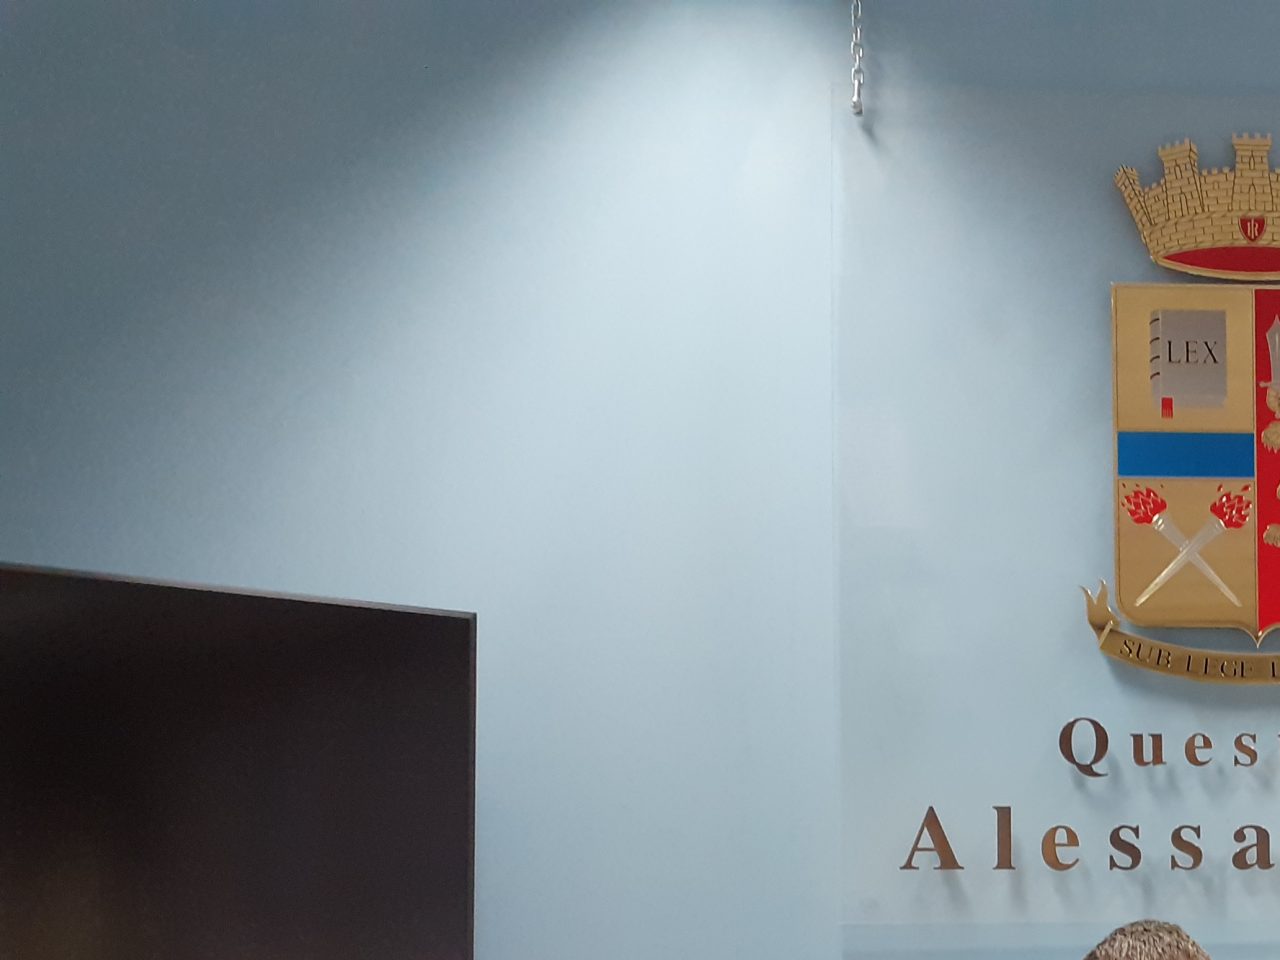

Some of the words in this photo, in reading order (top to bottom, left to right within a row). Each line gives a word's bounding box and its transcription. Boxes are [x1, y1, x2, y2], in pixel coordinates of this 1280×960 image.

[1167, 340, 1219, 364] LEX
[1119, 639, 1172, 668] SUB
[1185, 654, 1253, 678] LEGE
